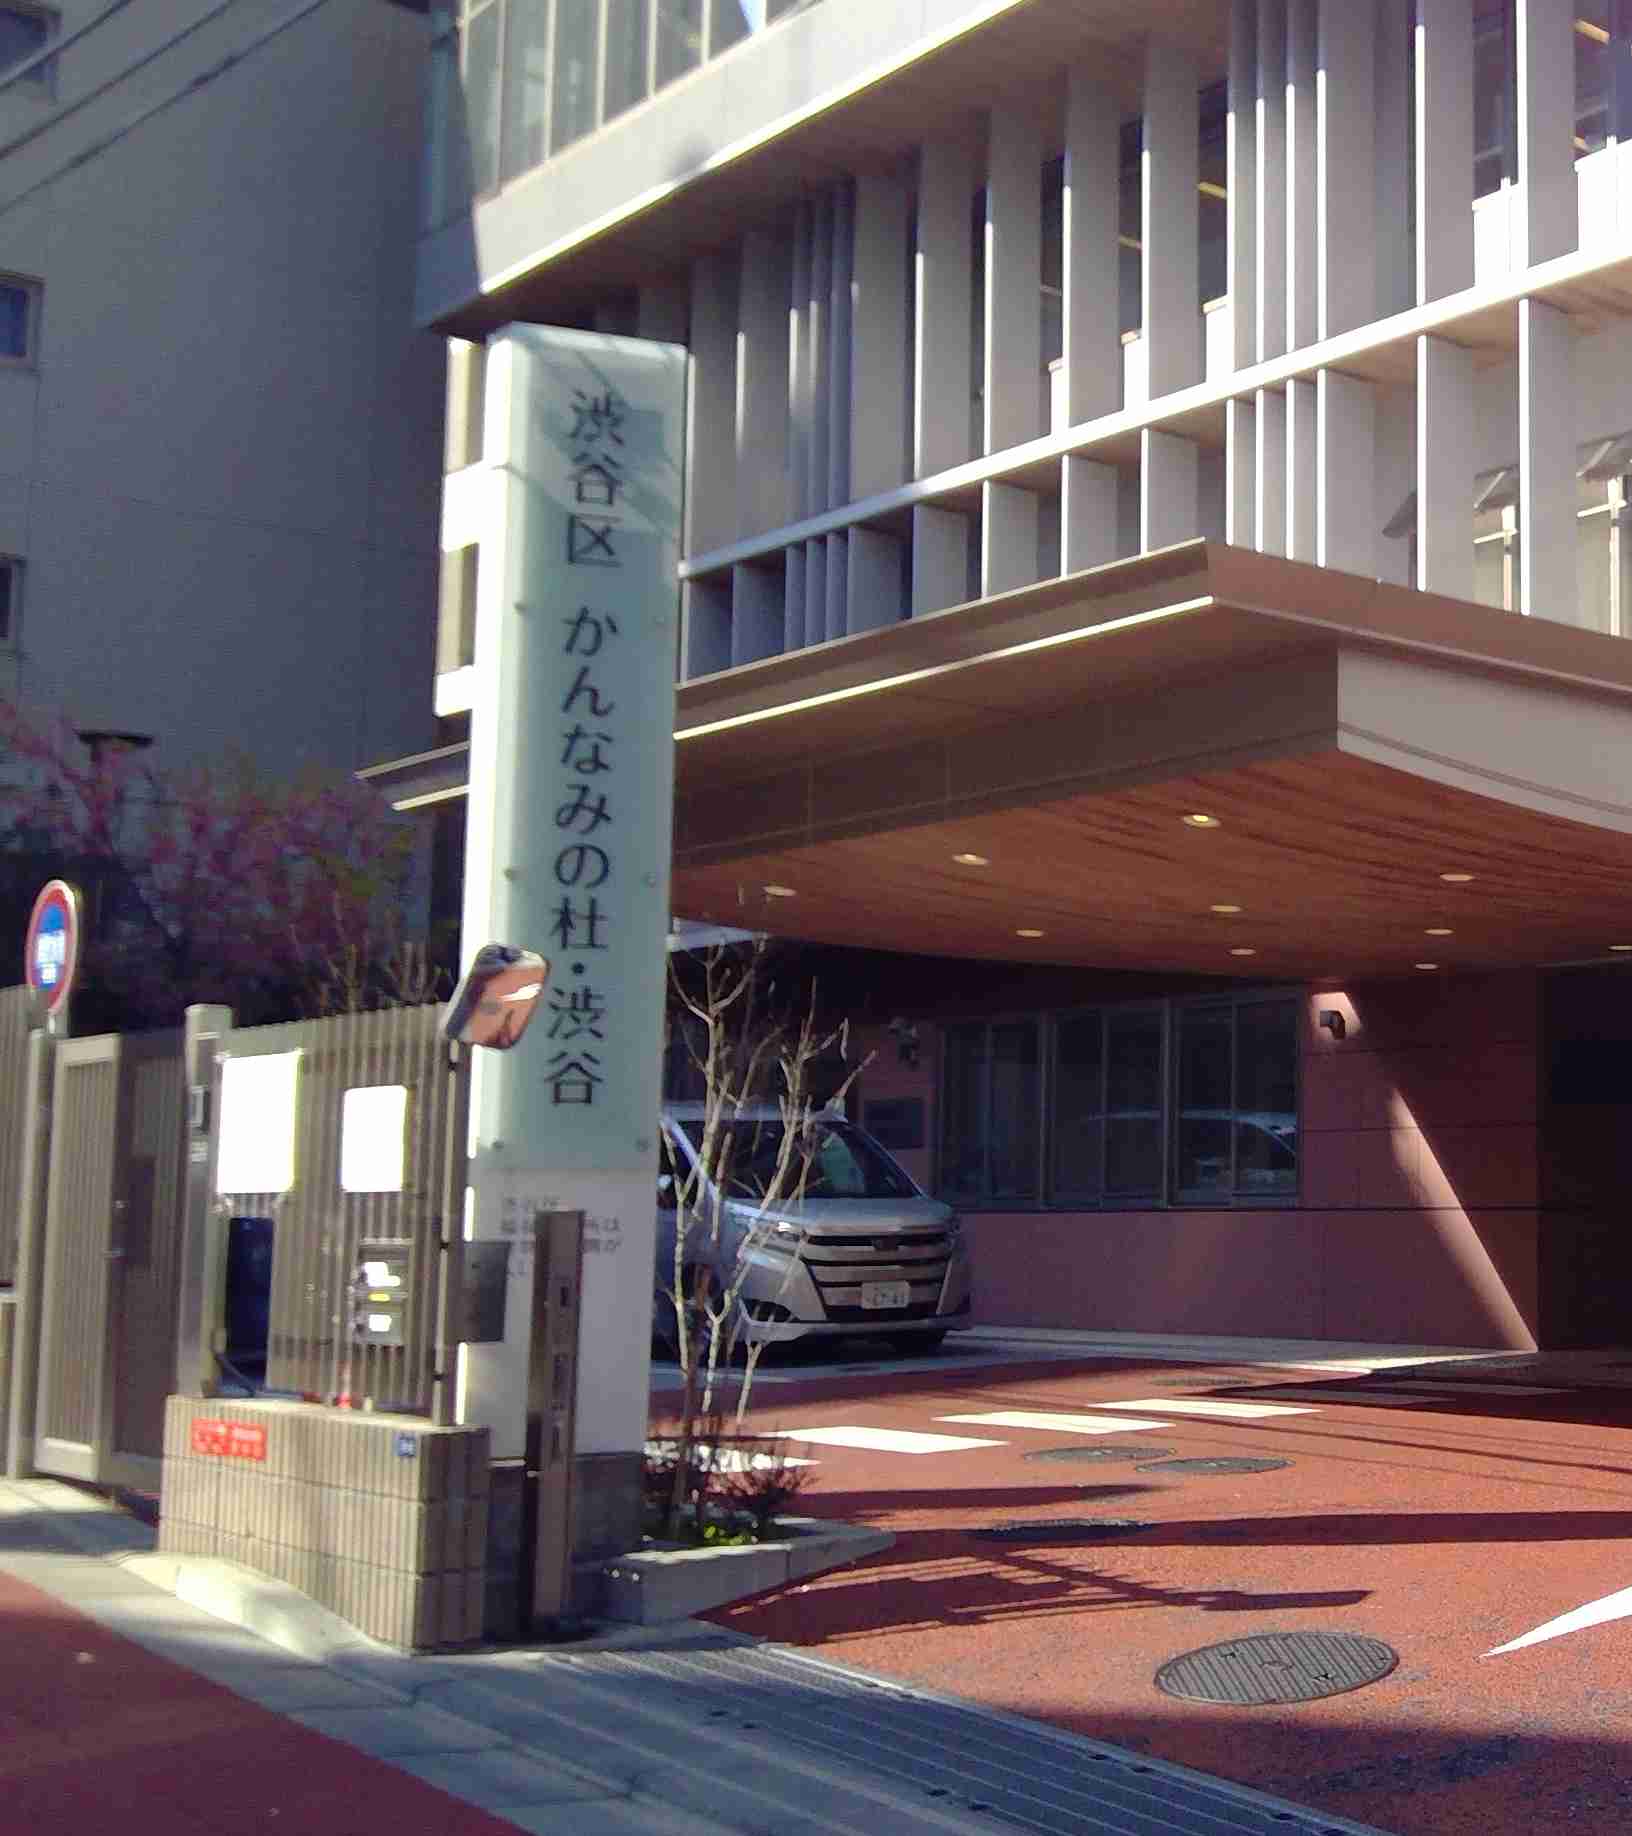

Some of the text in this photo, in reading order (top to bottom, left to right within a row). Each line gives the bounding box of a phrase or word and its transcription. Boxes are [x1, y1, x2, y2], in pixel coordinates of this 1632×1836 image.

[545, 387, 625, 1106] 渋谷区 かんなみの杜・渋谷
